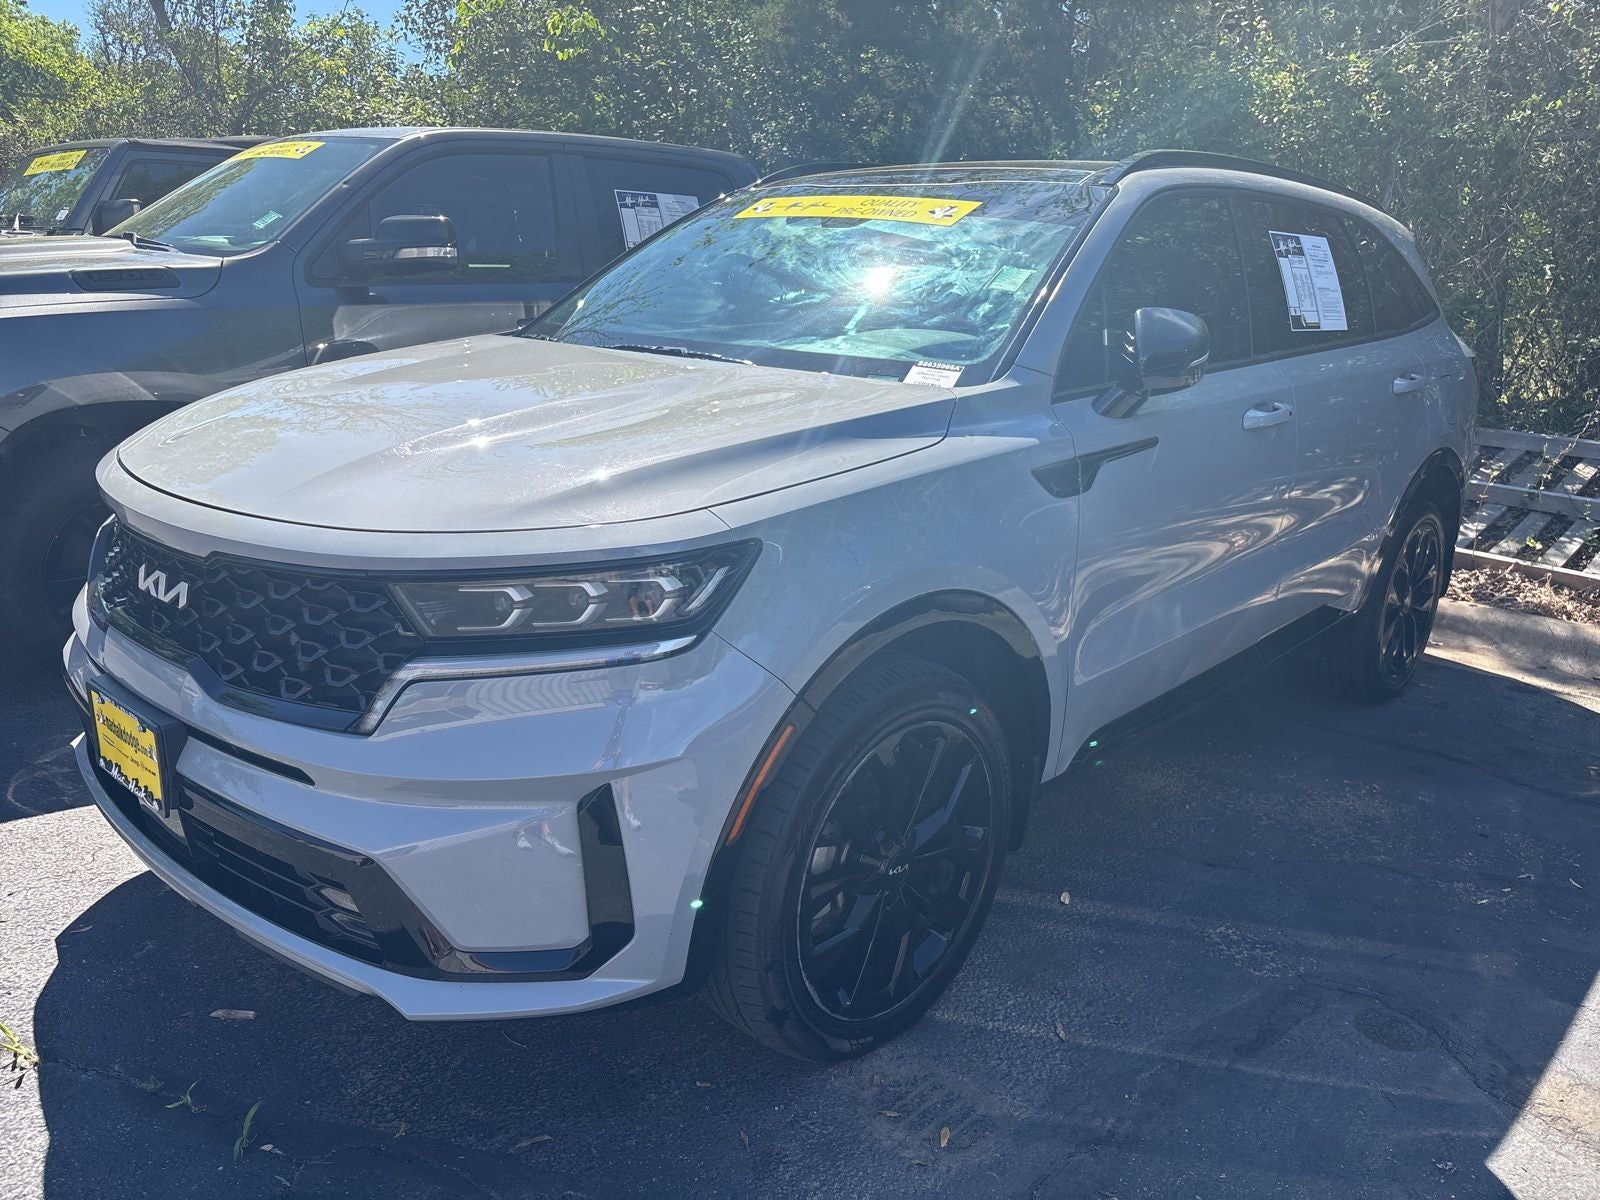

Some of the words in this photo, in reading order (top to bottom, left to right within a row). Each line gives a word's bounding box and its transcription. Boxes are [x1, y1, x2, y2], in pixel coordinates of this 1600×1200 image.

[860, 199, 917, 208] QUALITY
[138, 563, 188, 609] KIA
[889, 863, 909, 876] KIA
